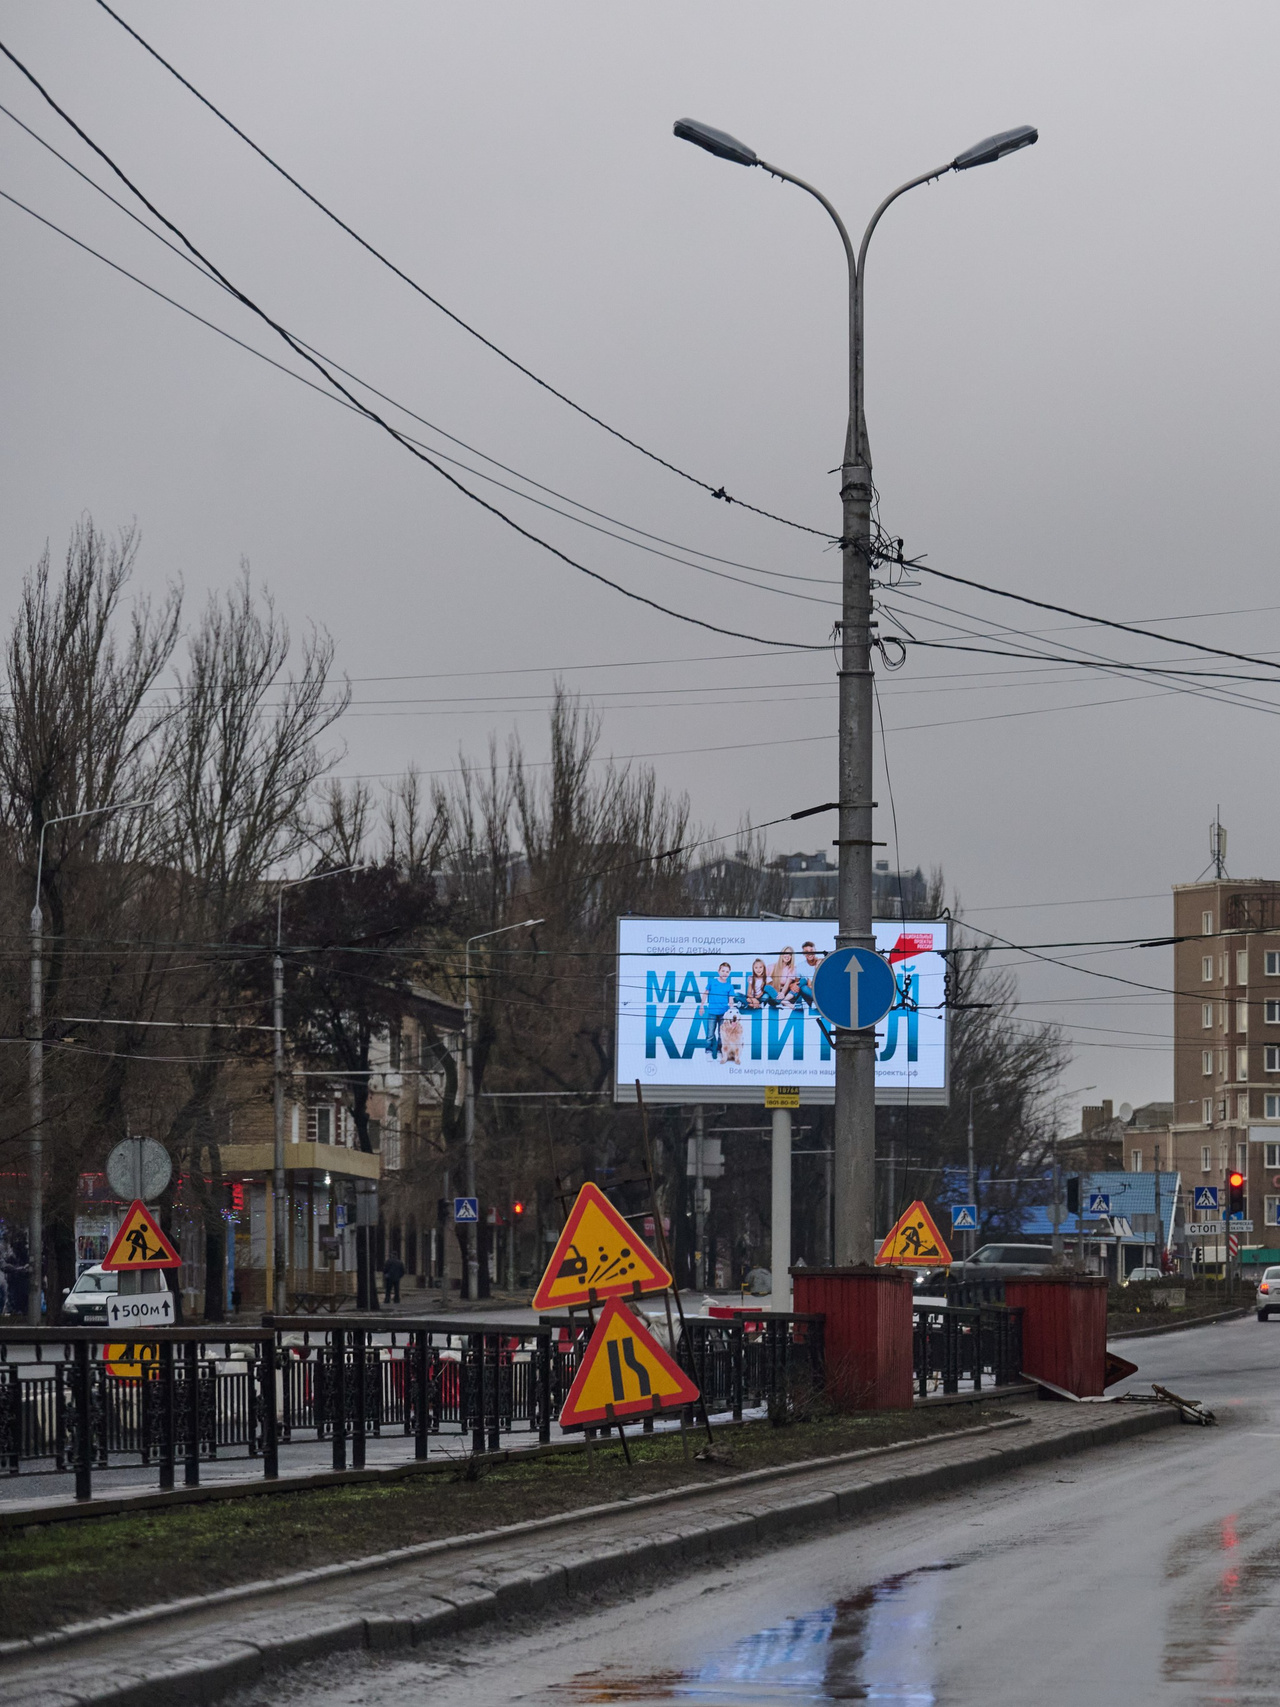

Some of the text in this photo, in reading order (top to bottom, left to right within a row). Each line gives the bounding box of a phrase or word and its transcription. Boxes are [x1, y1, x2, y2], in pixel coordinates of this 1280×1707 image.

[646, 934, 746, 945] Большая поддержка
[646, 945, 676, 954] семей
[686, 946, 721, 954] детьми
[645, 1005, 919, 1062] КАПИТЛ
[729, 1067, 743, 1075] Все
[744, 1068, 764, 1077] меры
[766, 1068, 807, 1077] поддержки
[1190, 1224, 1217, 1234] СТОП
